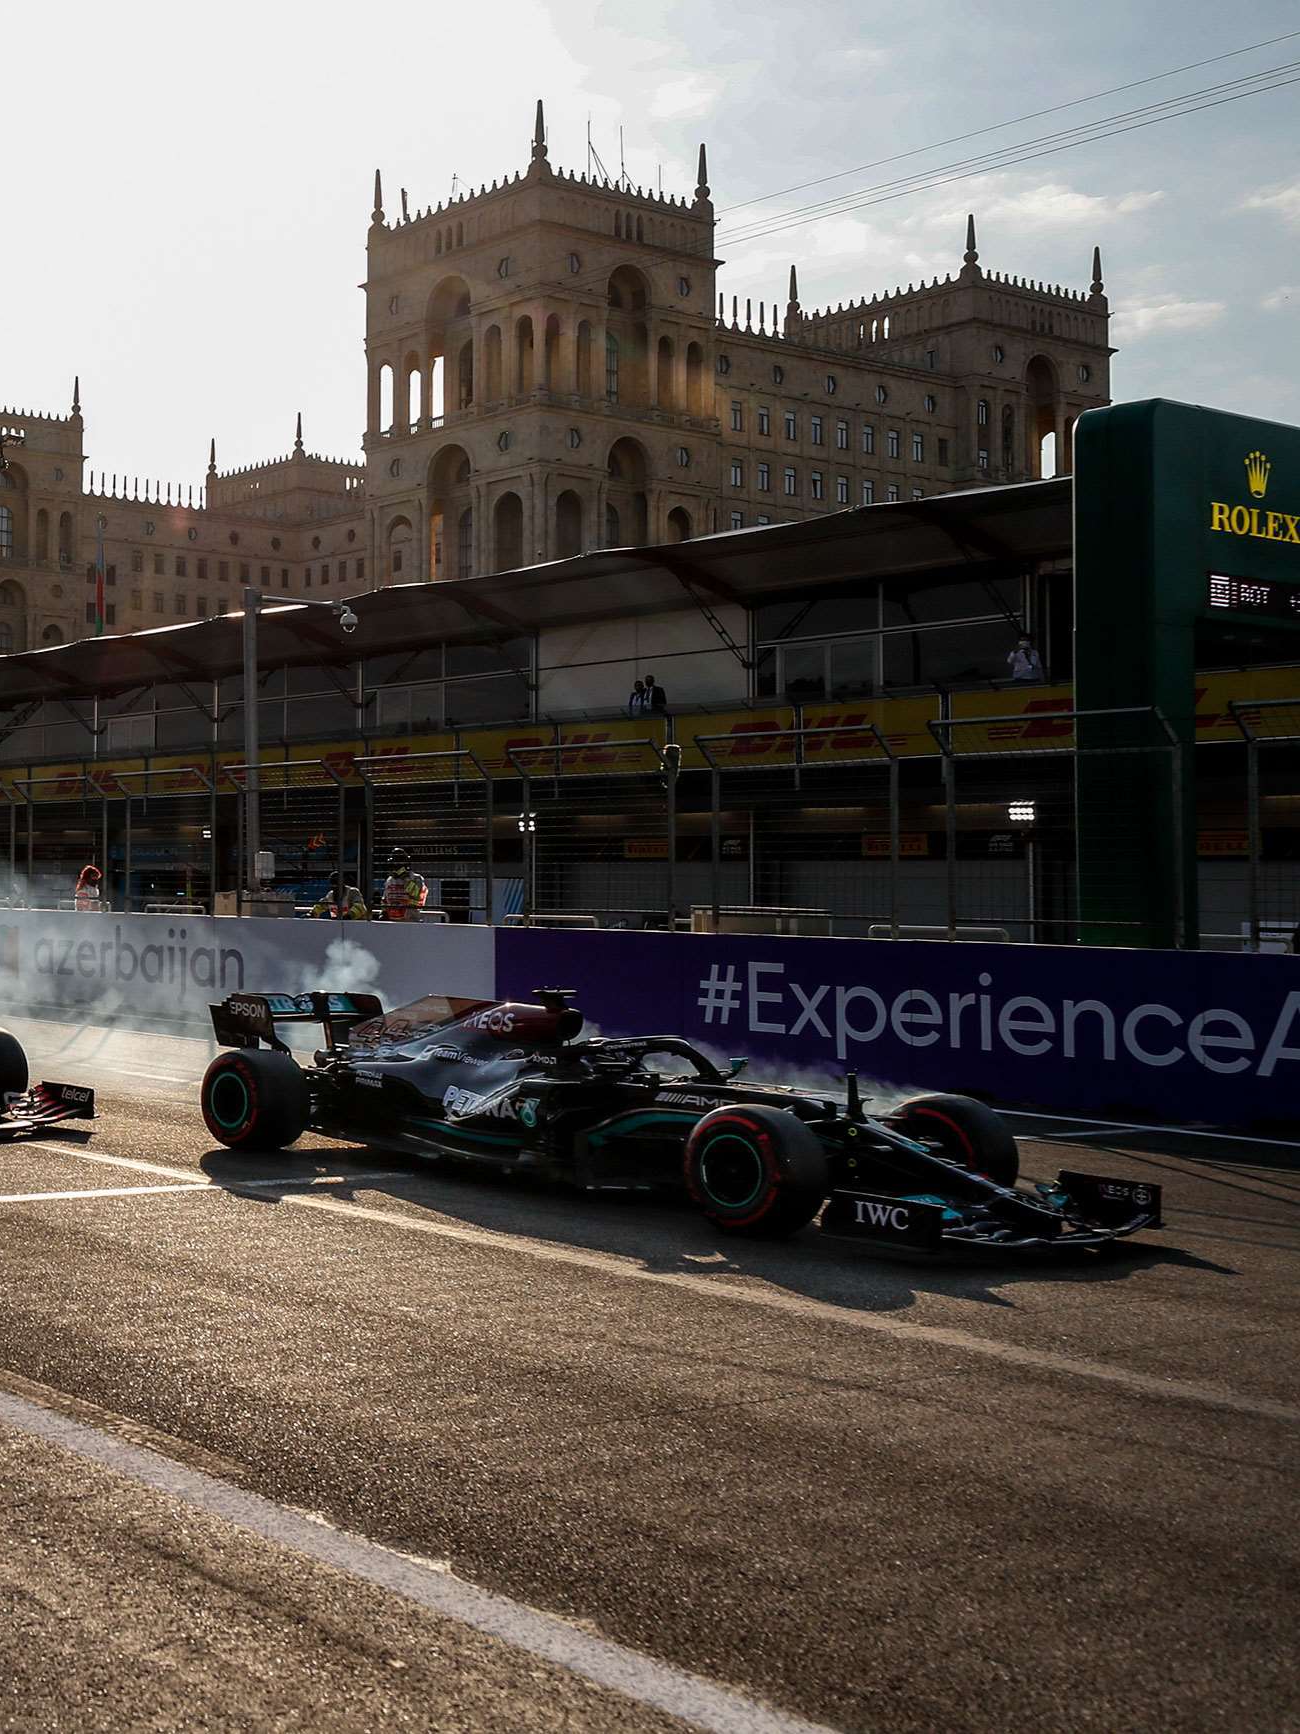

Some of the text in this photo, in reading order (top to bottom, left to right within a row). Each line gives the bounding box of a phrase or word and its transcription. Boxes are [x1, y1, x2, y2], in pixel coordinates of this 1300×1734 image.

[1210, 501, 1300, 544] ROLEX
[33, 925, 245, 999] azerbaijan
[229, 1001, 265, 1018] EPSON
[61, 1086, 90, 1103] telcel
[854, 1200, 910, 1230] IWC
